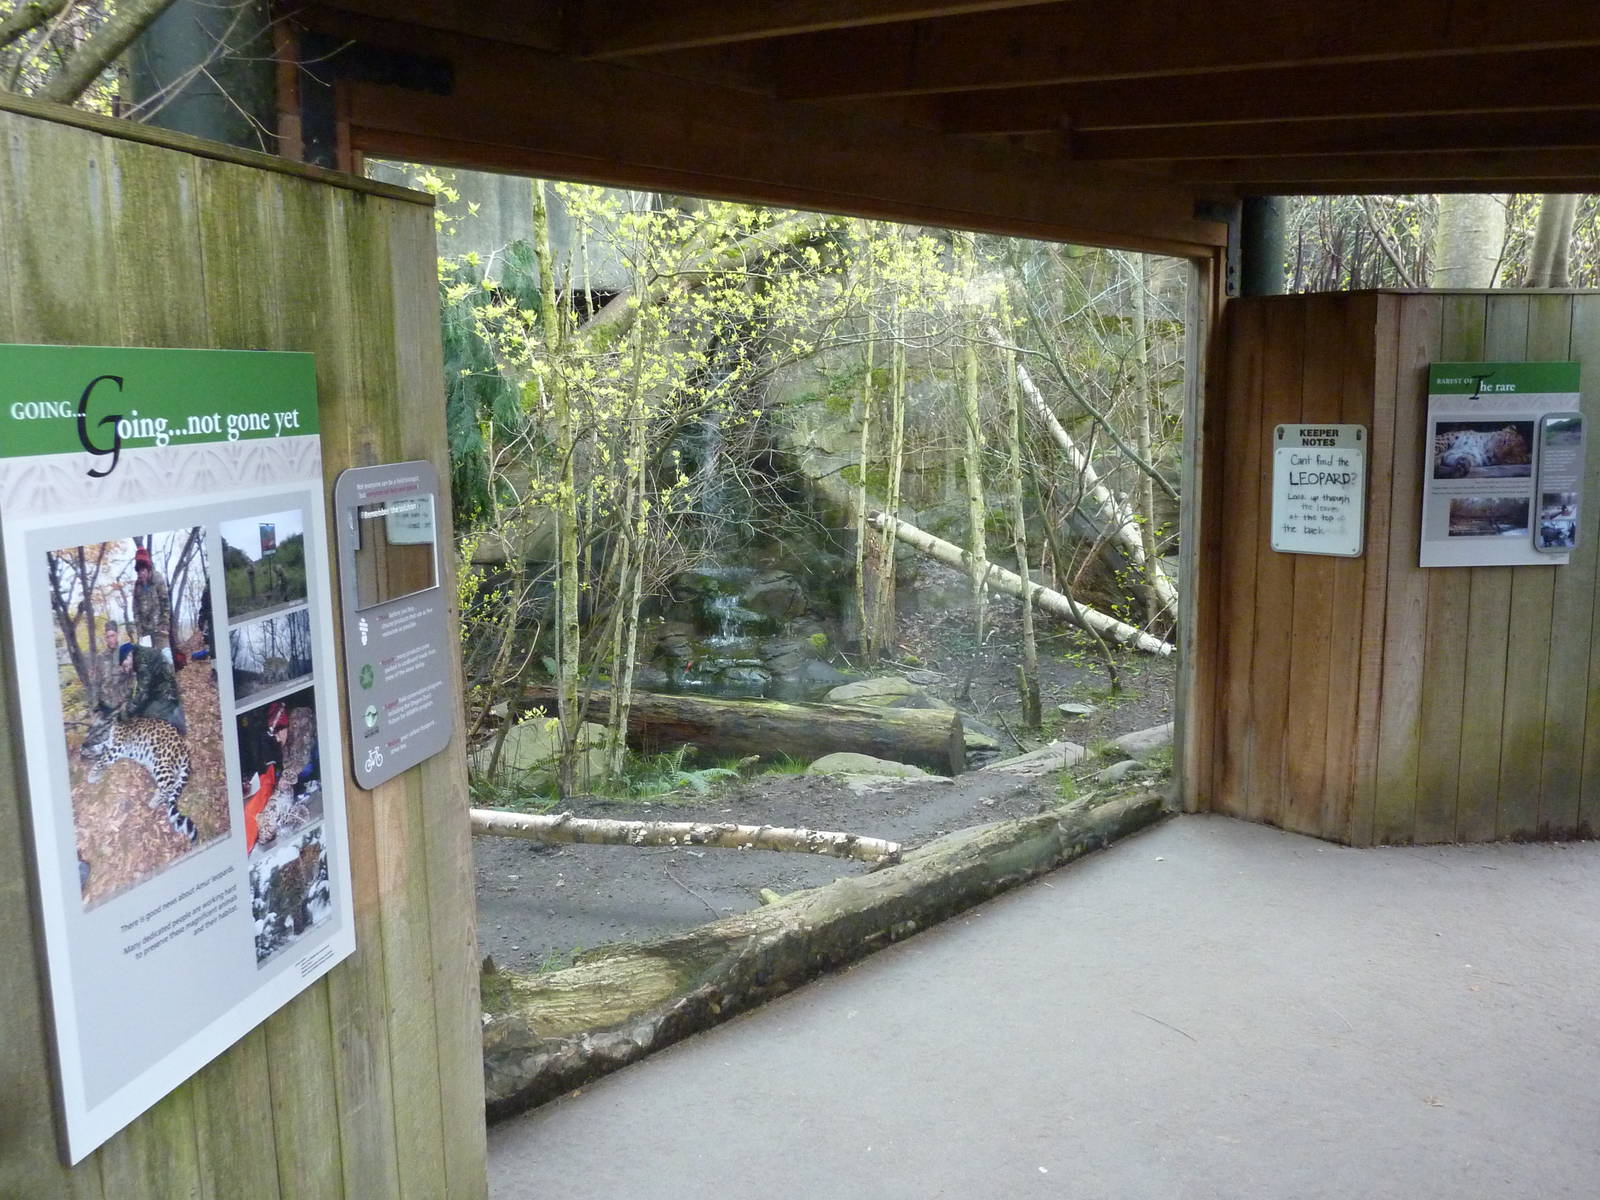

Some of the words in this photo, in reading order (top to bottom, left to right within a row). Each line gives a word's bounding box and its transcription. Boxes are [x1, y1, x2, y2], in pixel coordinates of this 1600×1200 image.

[1495, 383, 1516, 392] rare
[226, 413, 270, 441] gone
[274, 409, 300, 438] yet
[1299, 429, 1339, 437] KEEPER
[1302, 438, 1336, 447] NOTES
[1316, 454, 1333, 466] find
[1337, 456, 1350, 467] the
[1289, 471, 1358, 486] LEOPARD?
